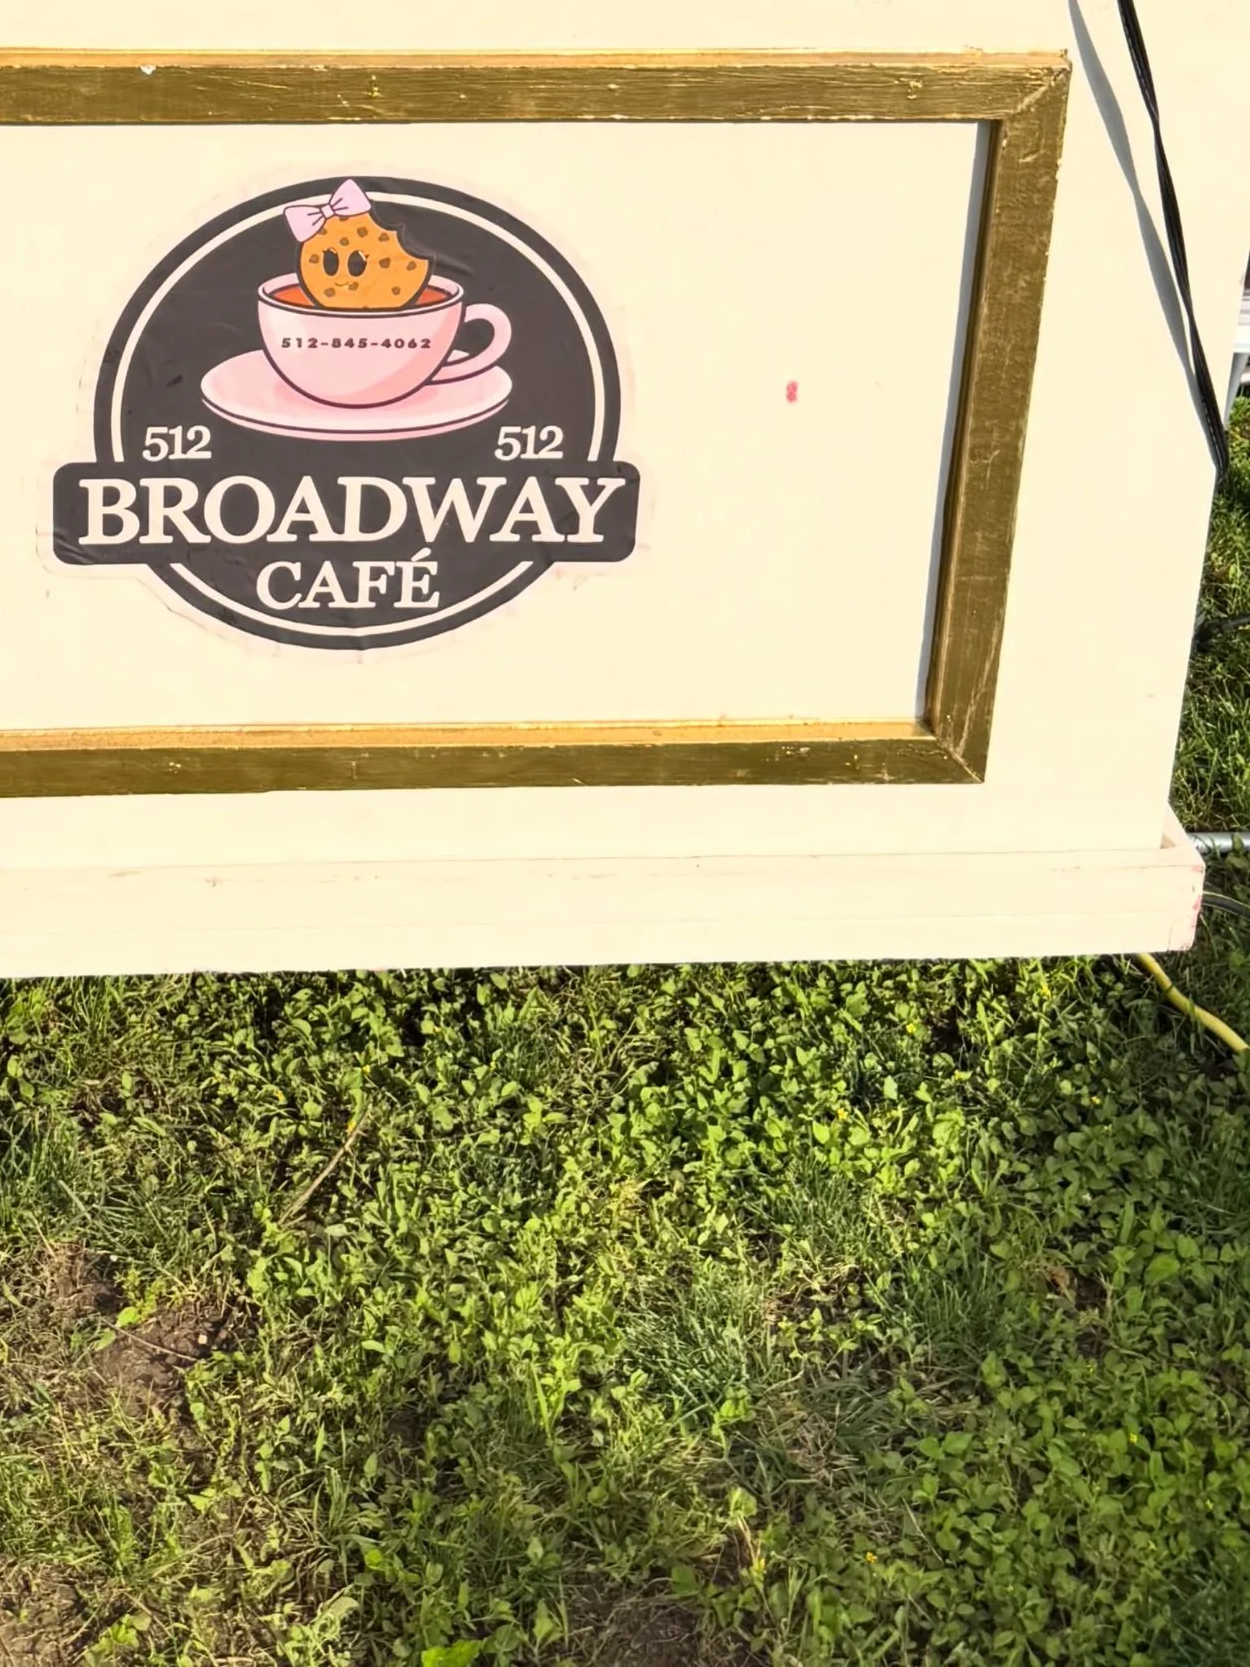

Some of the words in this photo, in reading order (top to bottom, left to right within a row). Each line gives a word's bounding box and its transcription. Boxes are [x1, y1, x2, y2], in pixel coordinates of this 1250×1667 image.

[281, 337, 431, 349] 512-845-4062
[142, 425, 212, 462] 512
[494, 425, 564, 461] 512
[78, 475, 626, 546] BROADWAY
[256, 547, 440, 611] CAFÉ
